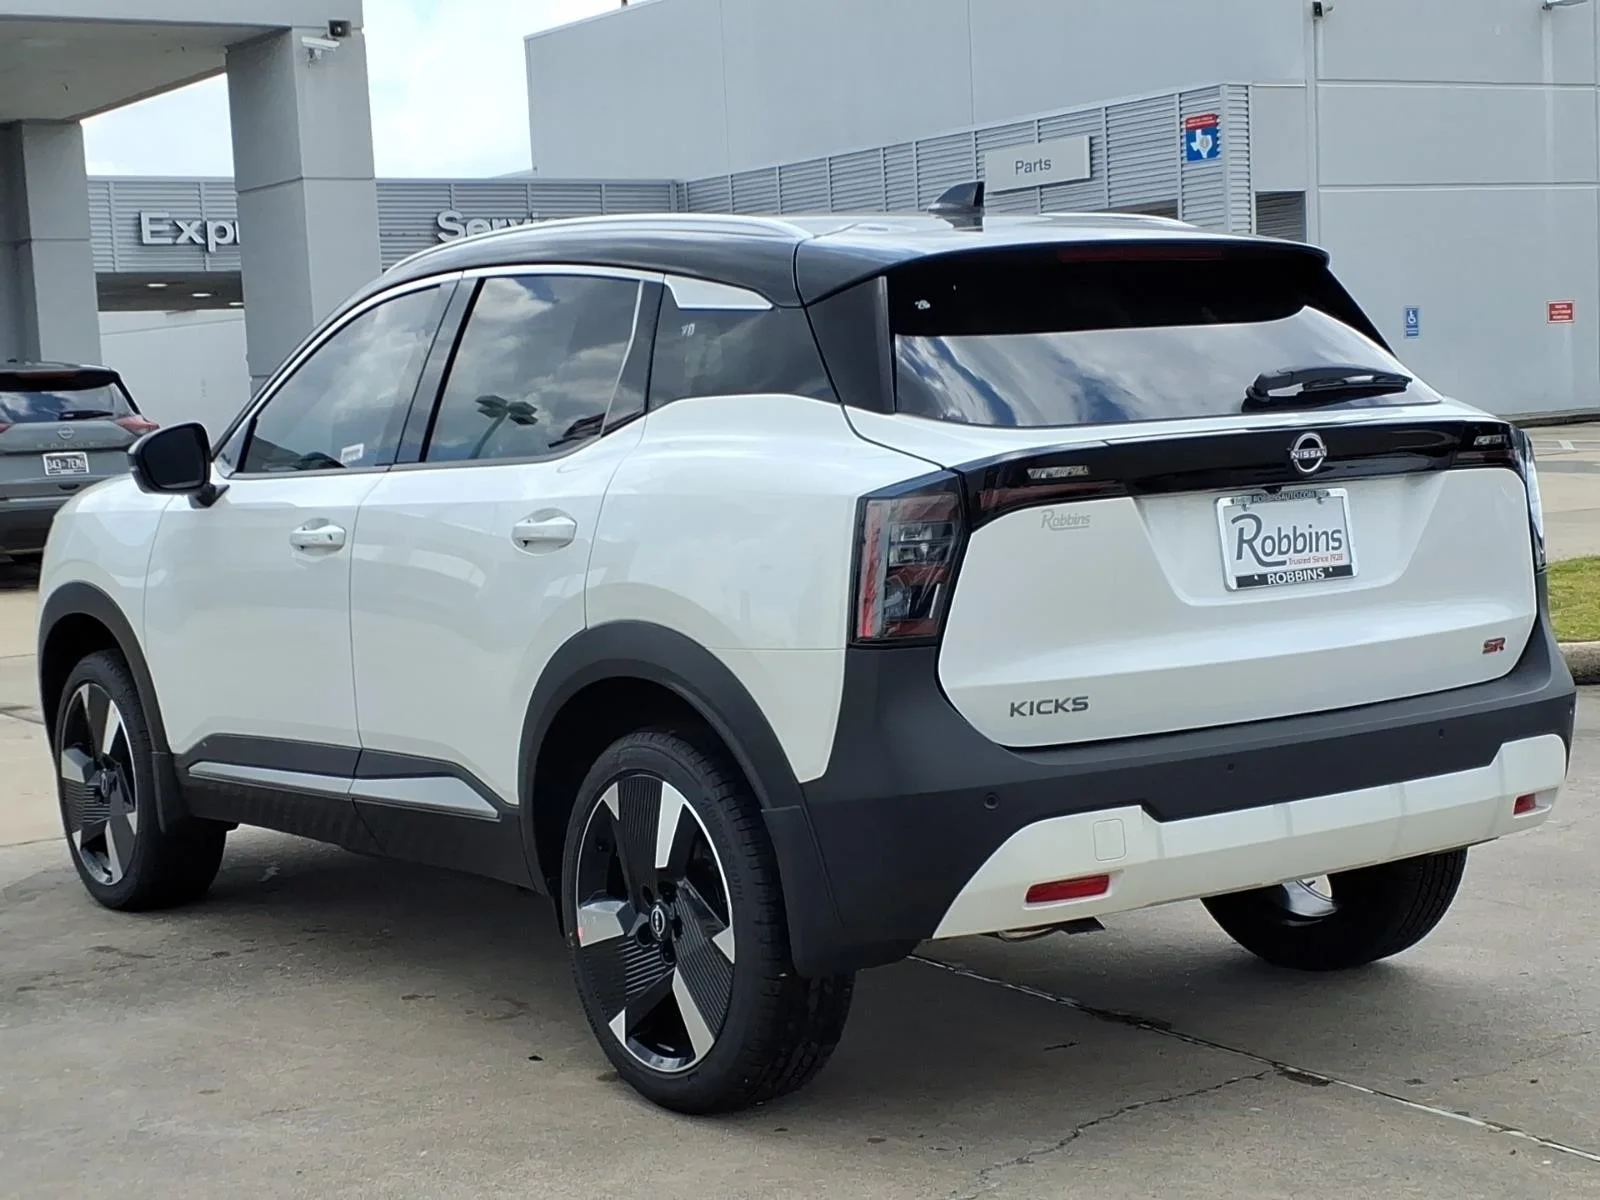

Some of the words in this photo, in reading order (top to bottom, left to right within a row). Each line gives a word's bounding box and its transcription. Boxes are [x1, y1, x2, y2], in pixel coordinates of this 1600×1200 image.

[1015, 158, 1052, 175] Parts
[1290, 447, 1327, 459] NISSAN
[1040, 508, 1091, 531] Robbins
[1231, 513, 1344, 568] Robbins
[1267, 568, 1325, 585] ROBBINS
[1482, 637, 1506, 655] SR
[1009, 696, 1089, 717] KICKS
